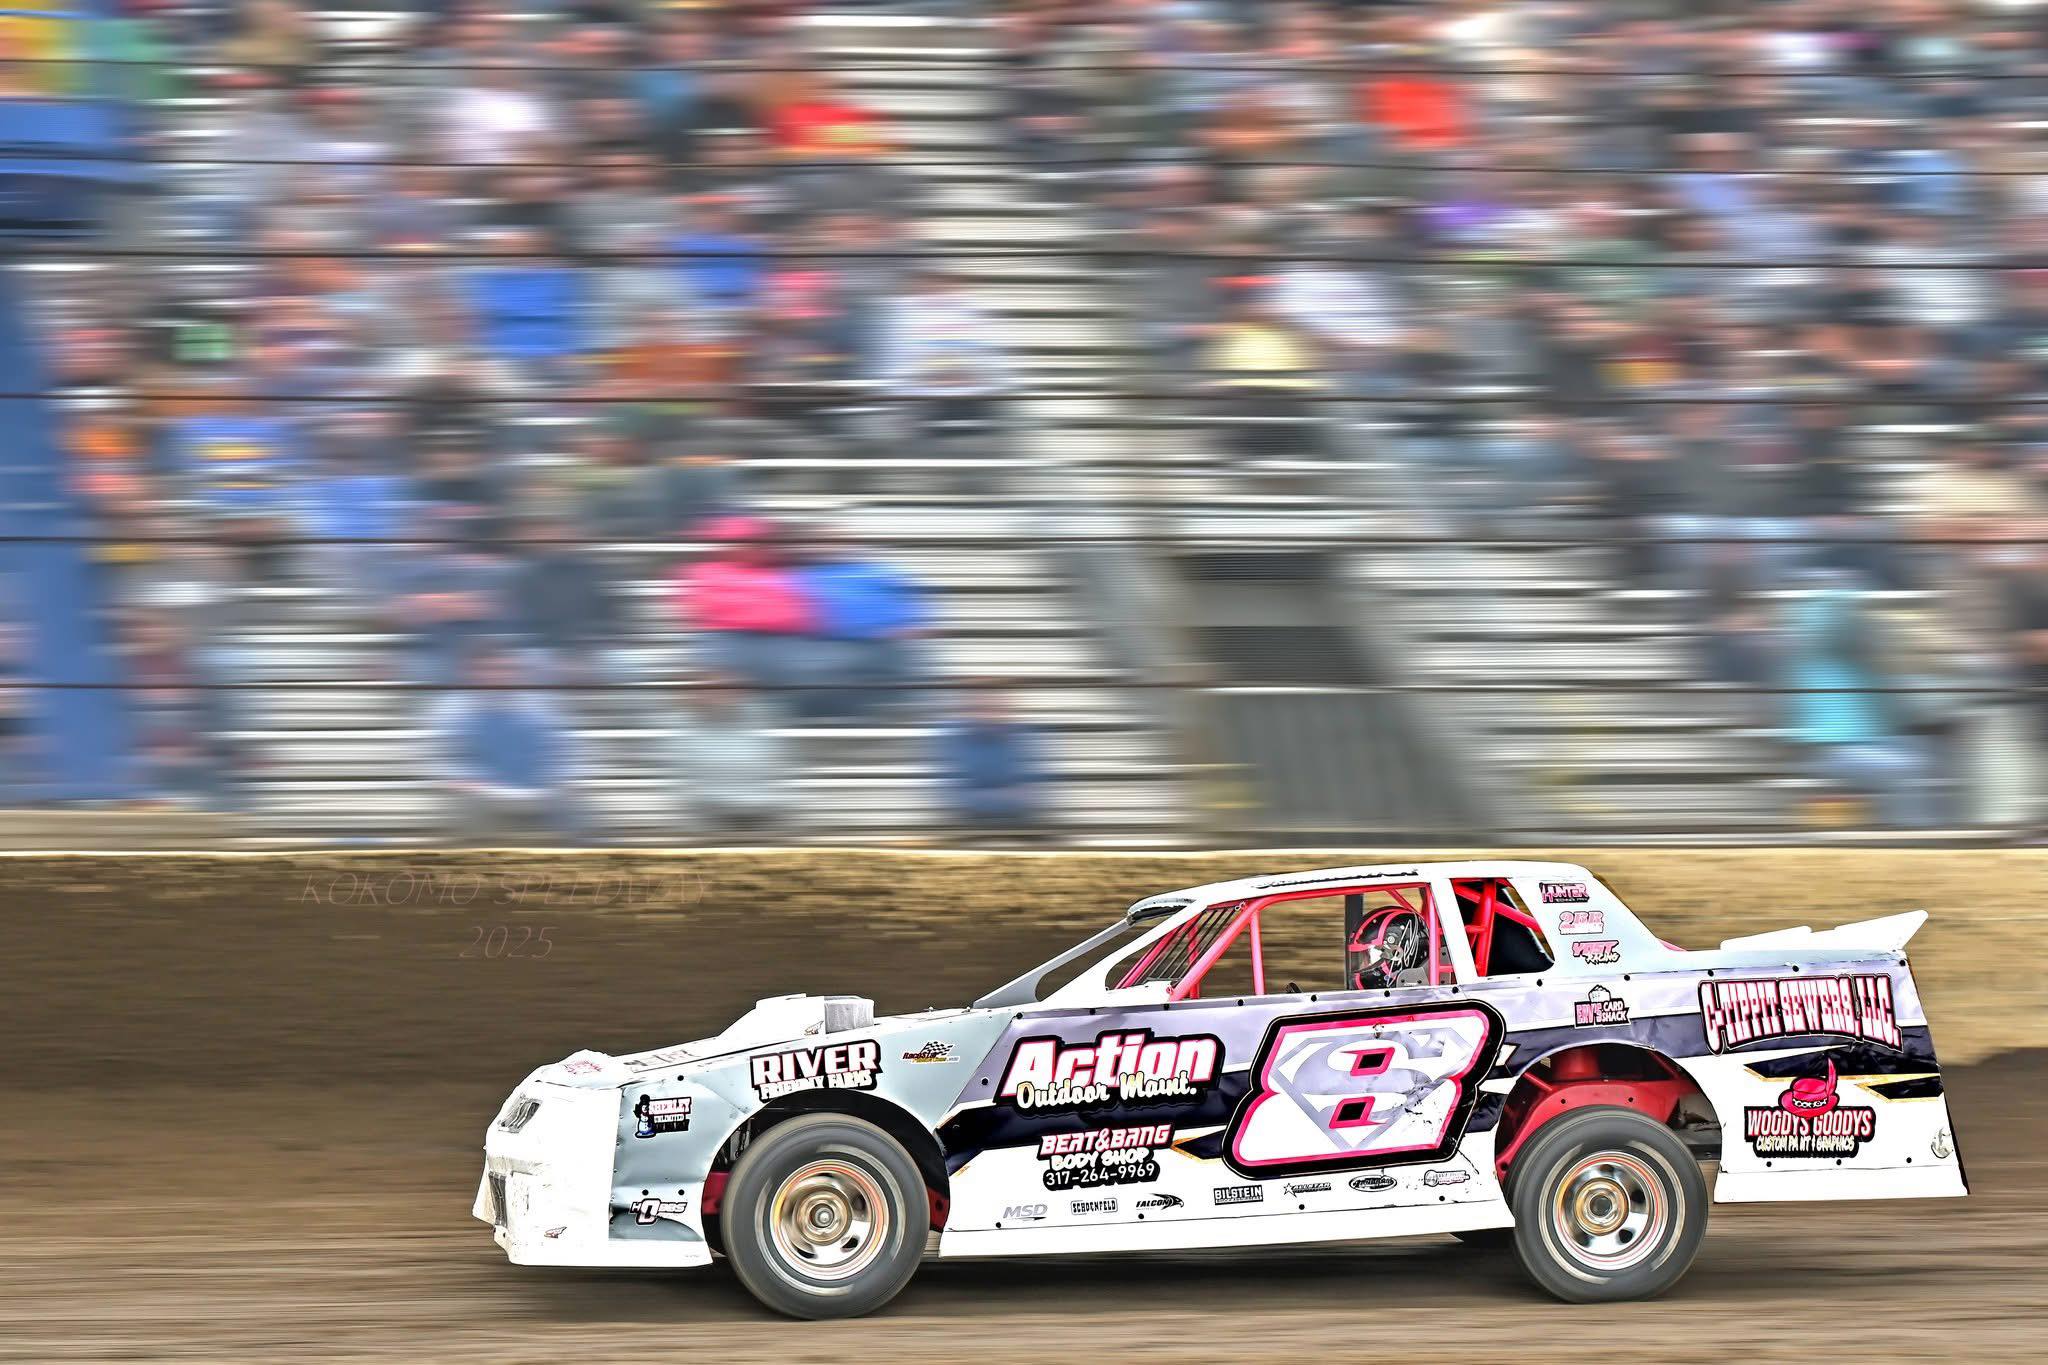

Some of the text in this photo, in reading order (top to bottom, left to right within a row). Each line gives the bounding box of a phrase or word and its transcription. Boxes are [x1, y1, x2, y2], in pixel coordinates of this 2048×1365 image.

[1602, 1010, 1627, 1022] SHACK
[1603, 1001, 1623, 1012] CARD
[752, 1042, 877, 1086] RIVER
[1001, 1034, 1216, 1096] Action
[1017, 1070, 1197, 1109] Outdoor Maint.
[1232, 1008, 1490, 1166] 8
[1747, 1109, 1873, 1137] WOODYS GOODYS
[1040, 1124, 1171, 1156] BEAT&BANG
[1051, 1147, 1149, 1171] BODY SHOP
[1045, 1162, 1155, 1186] 317-264-9969
[1136, 1199, 1169, 1208] FALCON
[1214, 1187, 1262, 1200] BILSTEIN
[1003, 1204, 1048, 1219] MSD
[1072, 1200, 1117, 1213] SCHOENFELD
